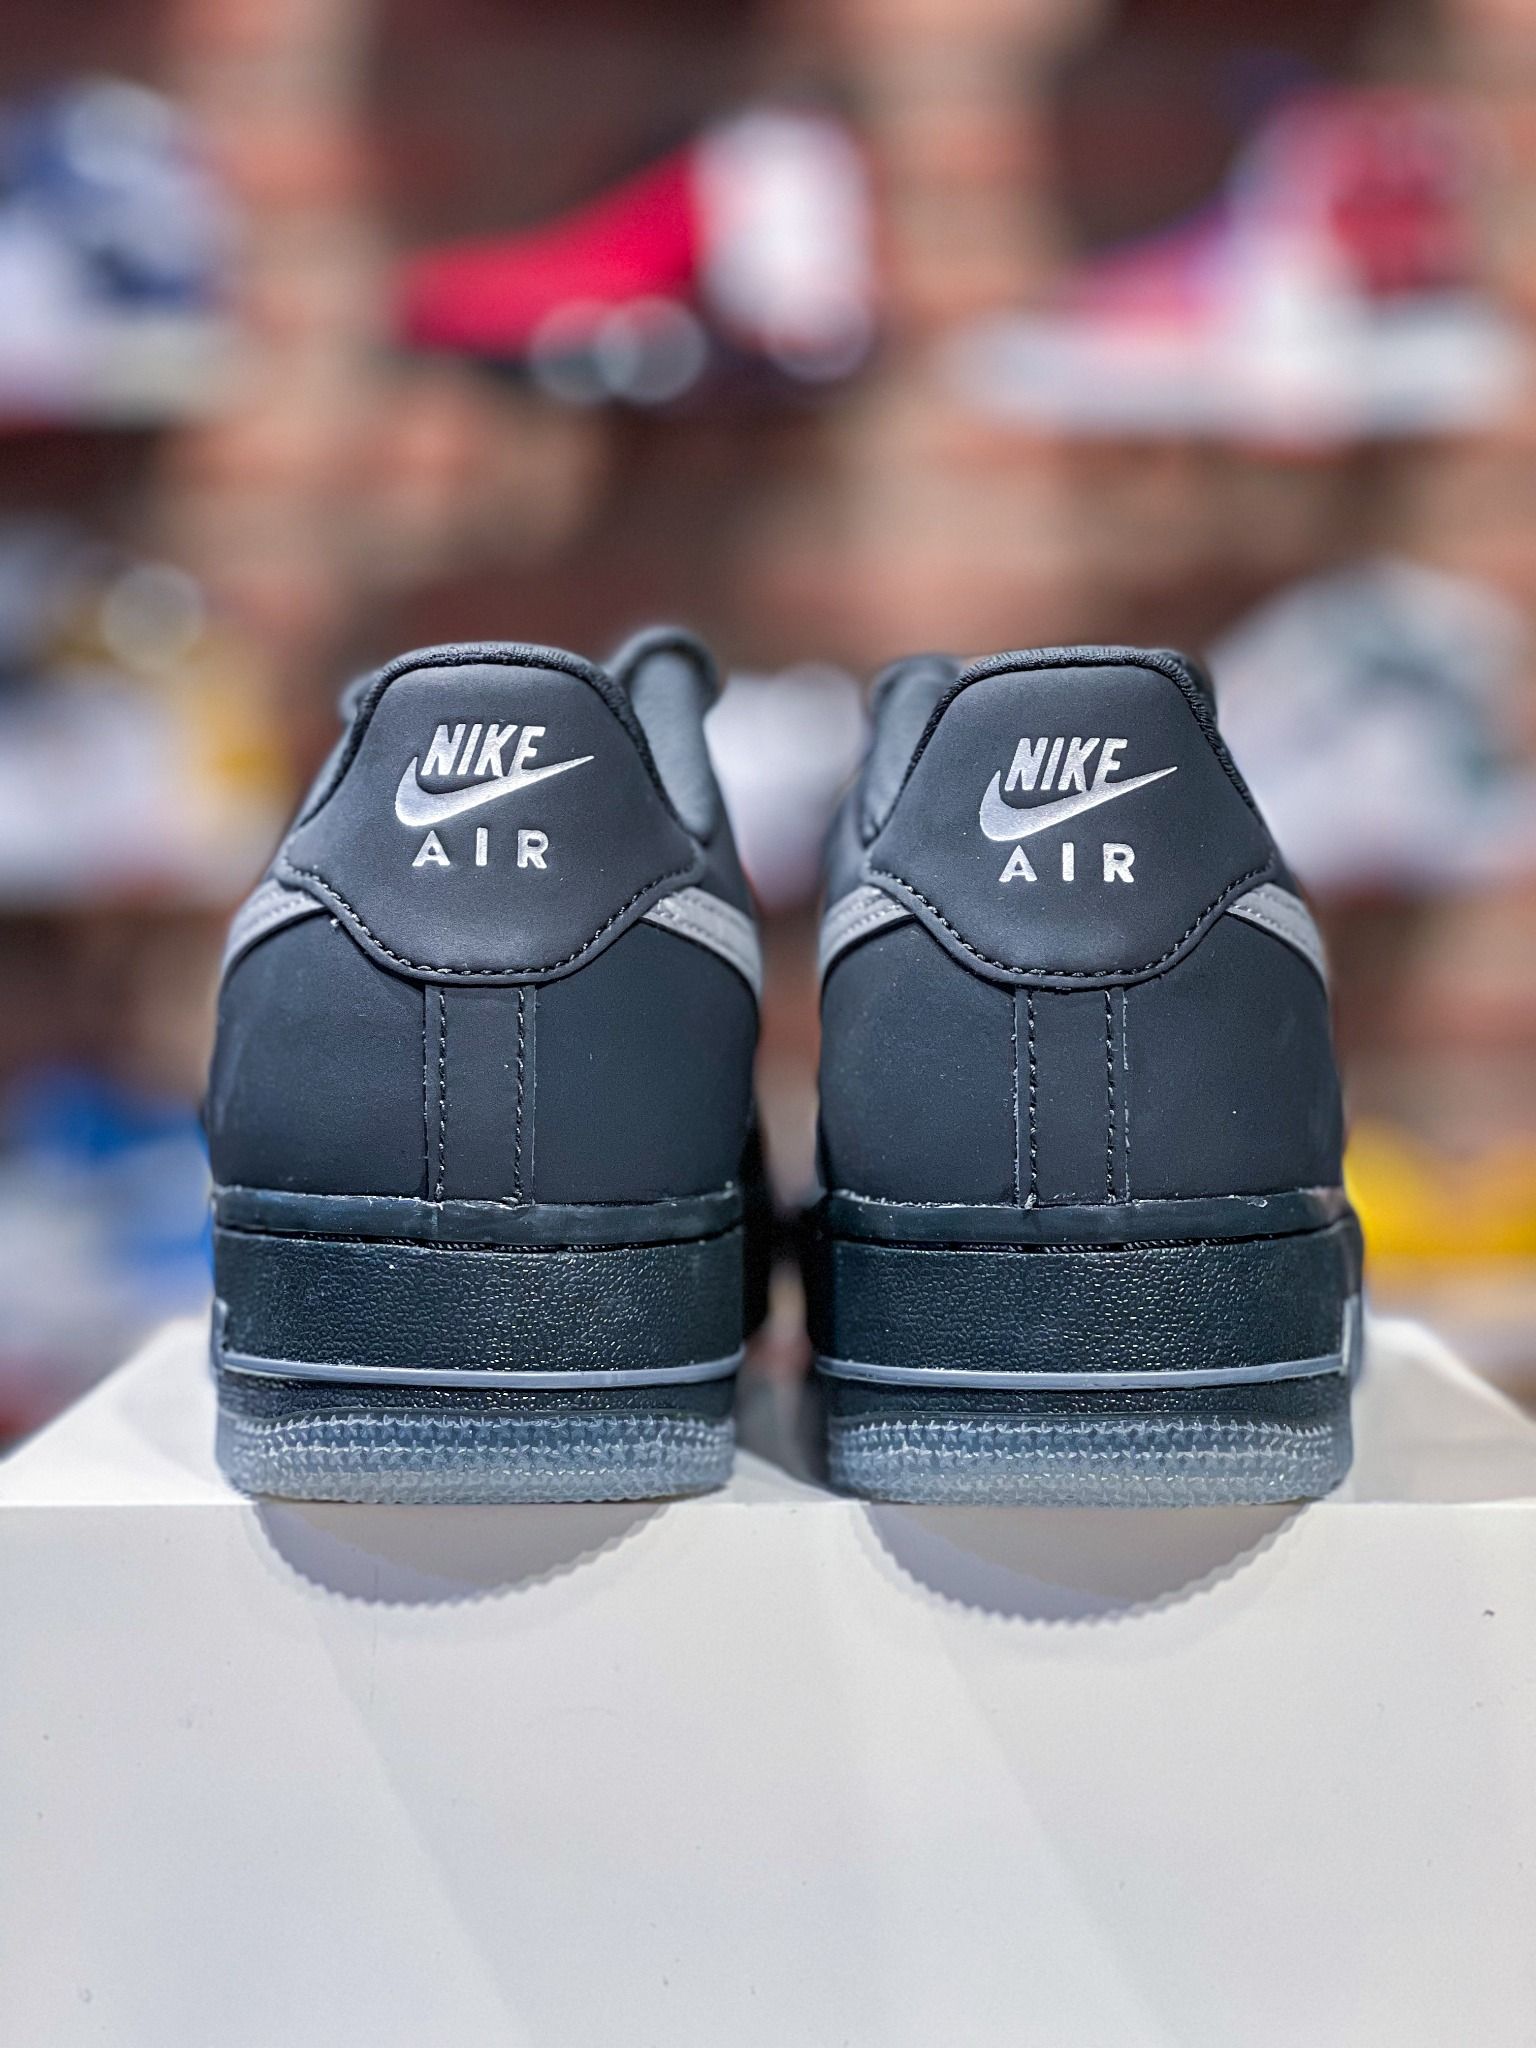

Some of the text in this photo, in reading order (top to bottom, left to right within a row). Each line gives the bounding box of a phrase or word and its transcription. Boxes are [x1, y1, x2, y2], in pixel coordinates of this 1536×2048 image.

[420, 723, 546, 777] NIKE
[1004, 737, 1128, 791] NIKE
[412, 827, 549, 869] AIR
[998, 842, 1135, 883] AIR
